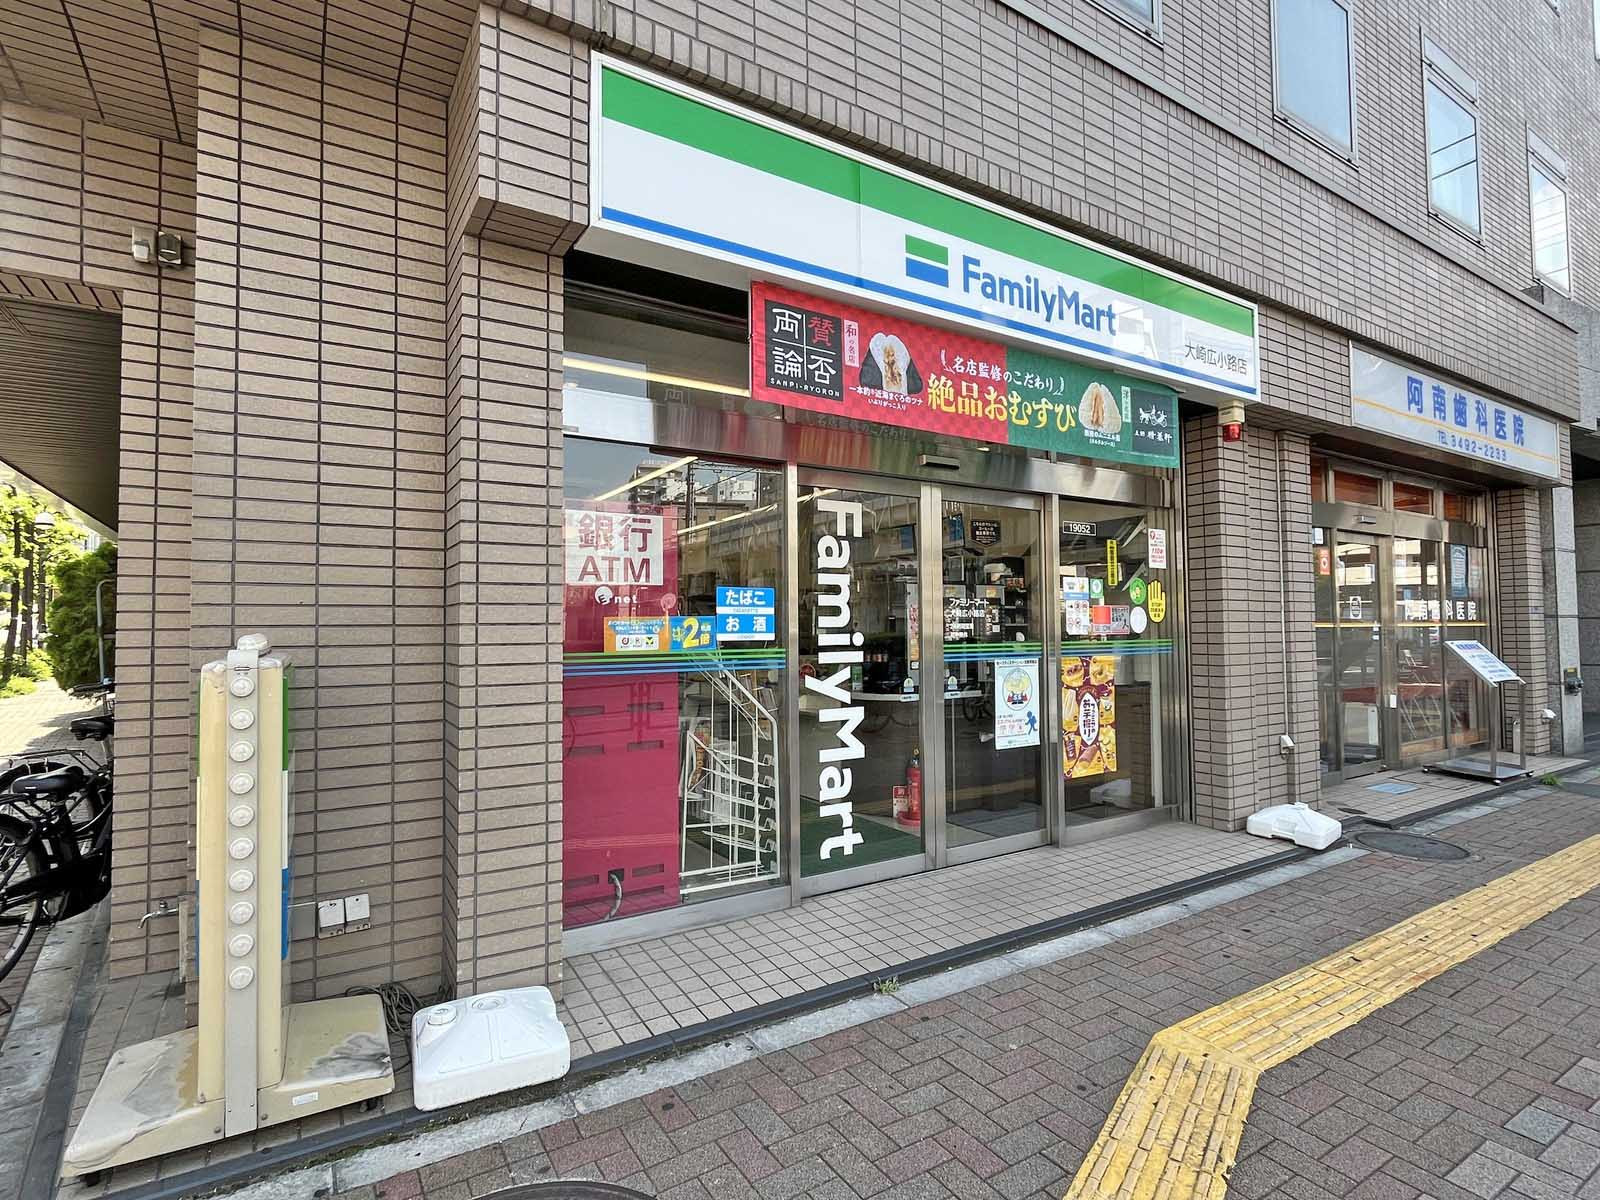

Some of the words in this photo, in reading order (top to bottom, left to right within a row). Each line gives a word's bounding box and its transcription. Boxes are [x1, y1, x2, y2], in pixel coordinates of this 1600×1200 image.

[962, 254, 1116, 337] FamilyMart
[1184, 336, 1248, 376] 大崎広小路店
[770, 377, 840, 397] SANPI-RYORON
[927, 373, 1077, 433] 絶品おむすび
[1406, 375, 1525, 447] 阿南歯科医院
[1437, 430, 1449, 446] TEL
[577, 512, 653, 553] 銀行
[1069, 522, 1091, 534] 19052
[577, 555, 651, 583] ATM
[725, 589, 767, 606] たばこ
[948, 598, 990, 608] ファミリーマート
[804, 498, 866, 861] FamilyMart
